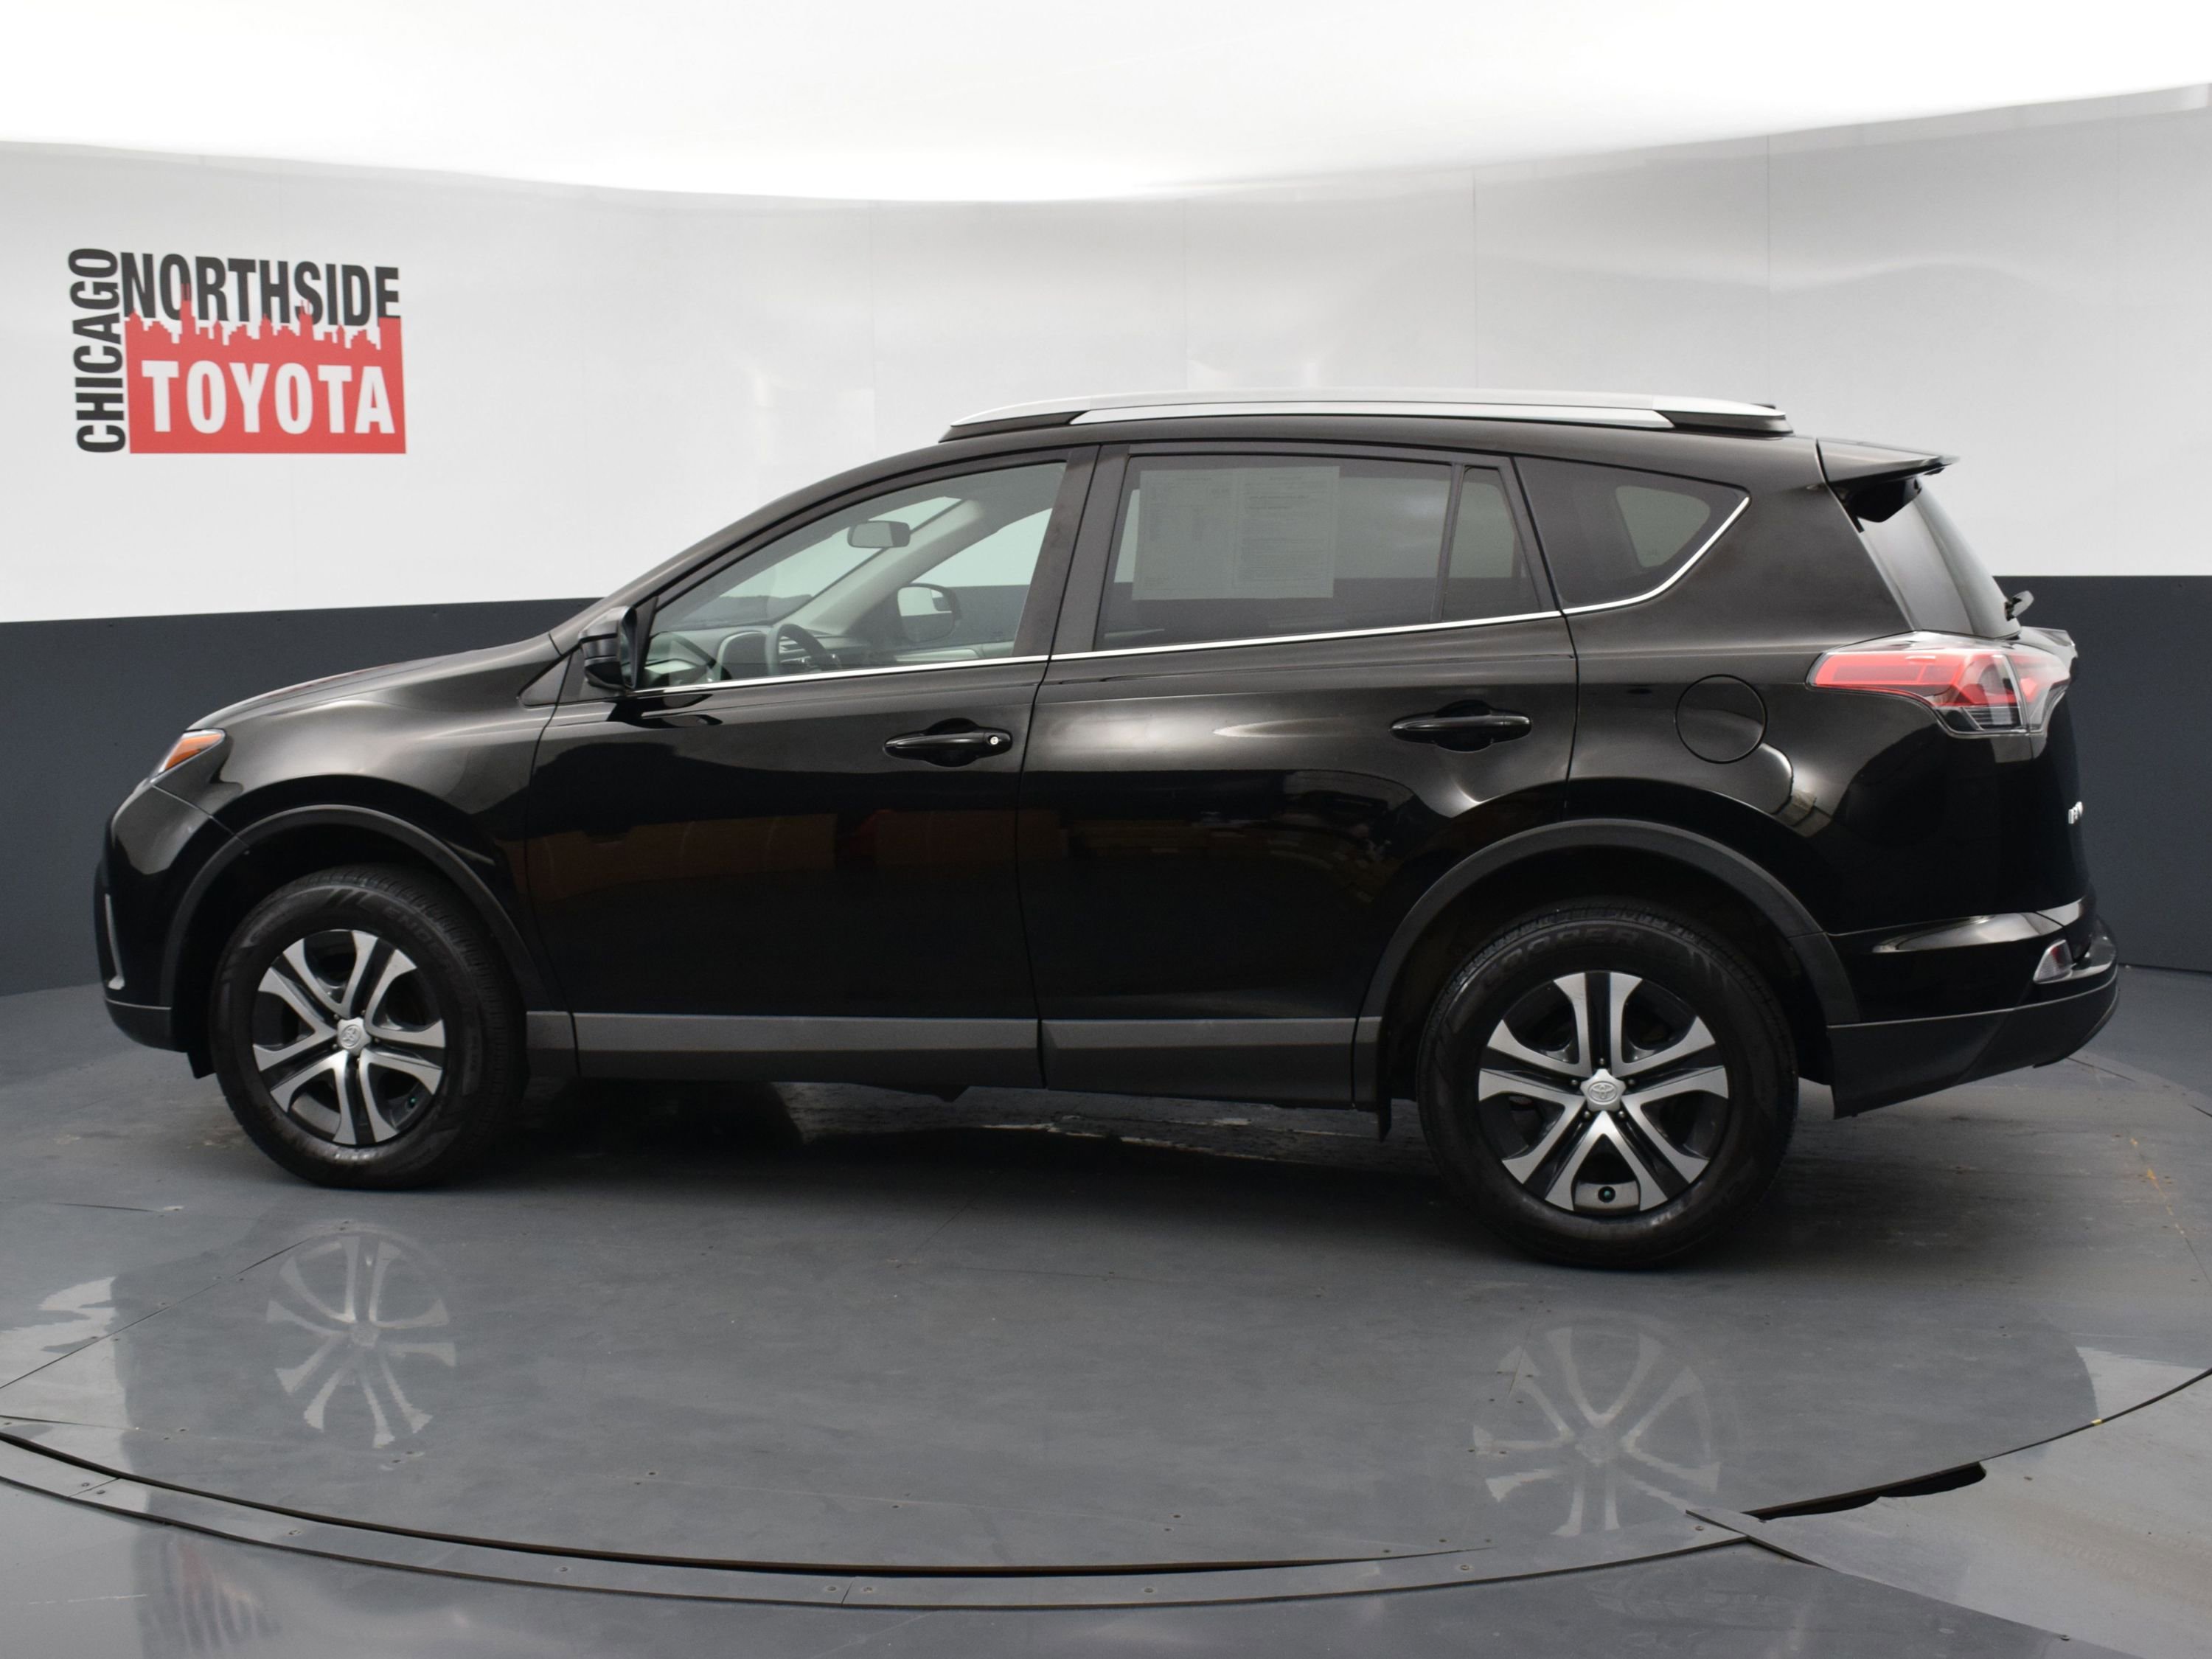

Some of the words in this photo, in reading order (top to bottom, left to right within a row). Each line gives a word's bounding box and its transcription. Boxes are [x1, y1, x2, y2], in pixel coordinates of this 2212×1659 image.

[120, 251, 401, 327] NORTHSIDE
[68, 248, 126, 453] CHICAGO
[141, 360, 396, 434] TOYOTA
